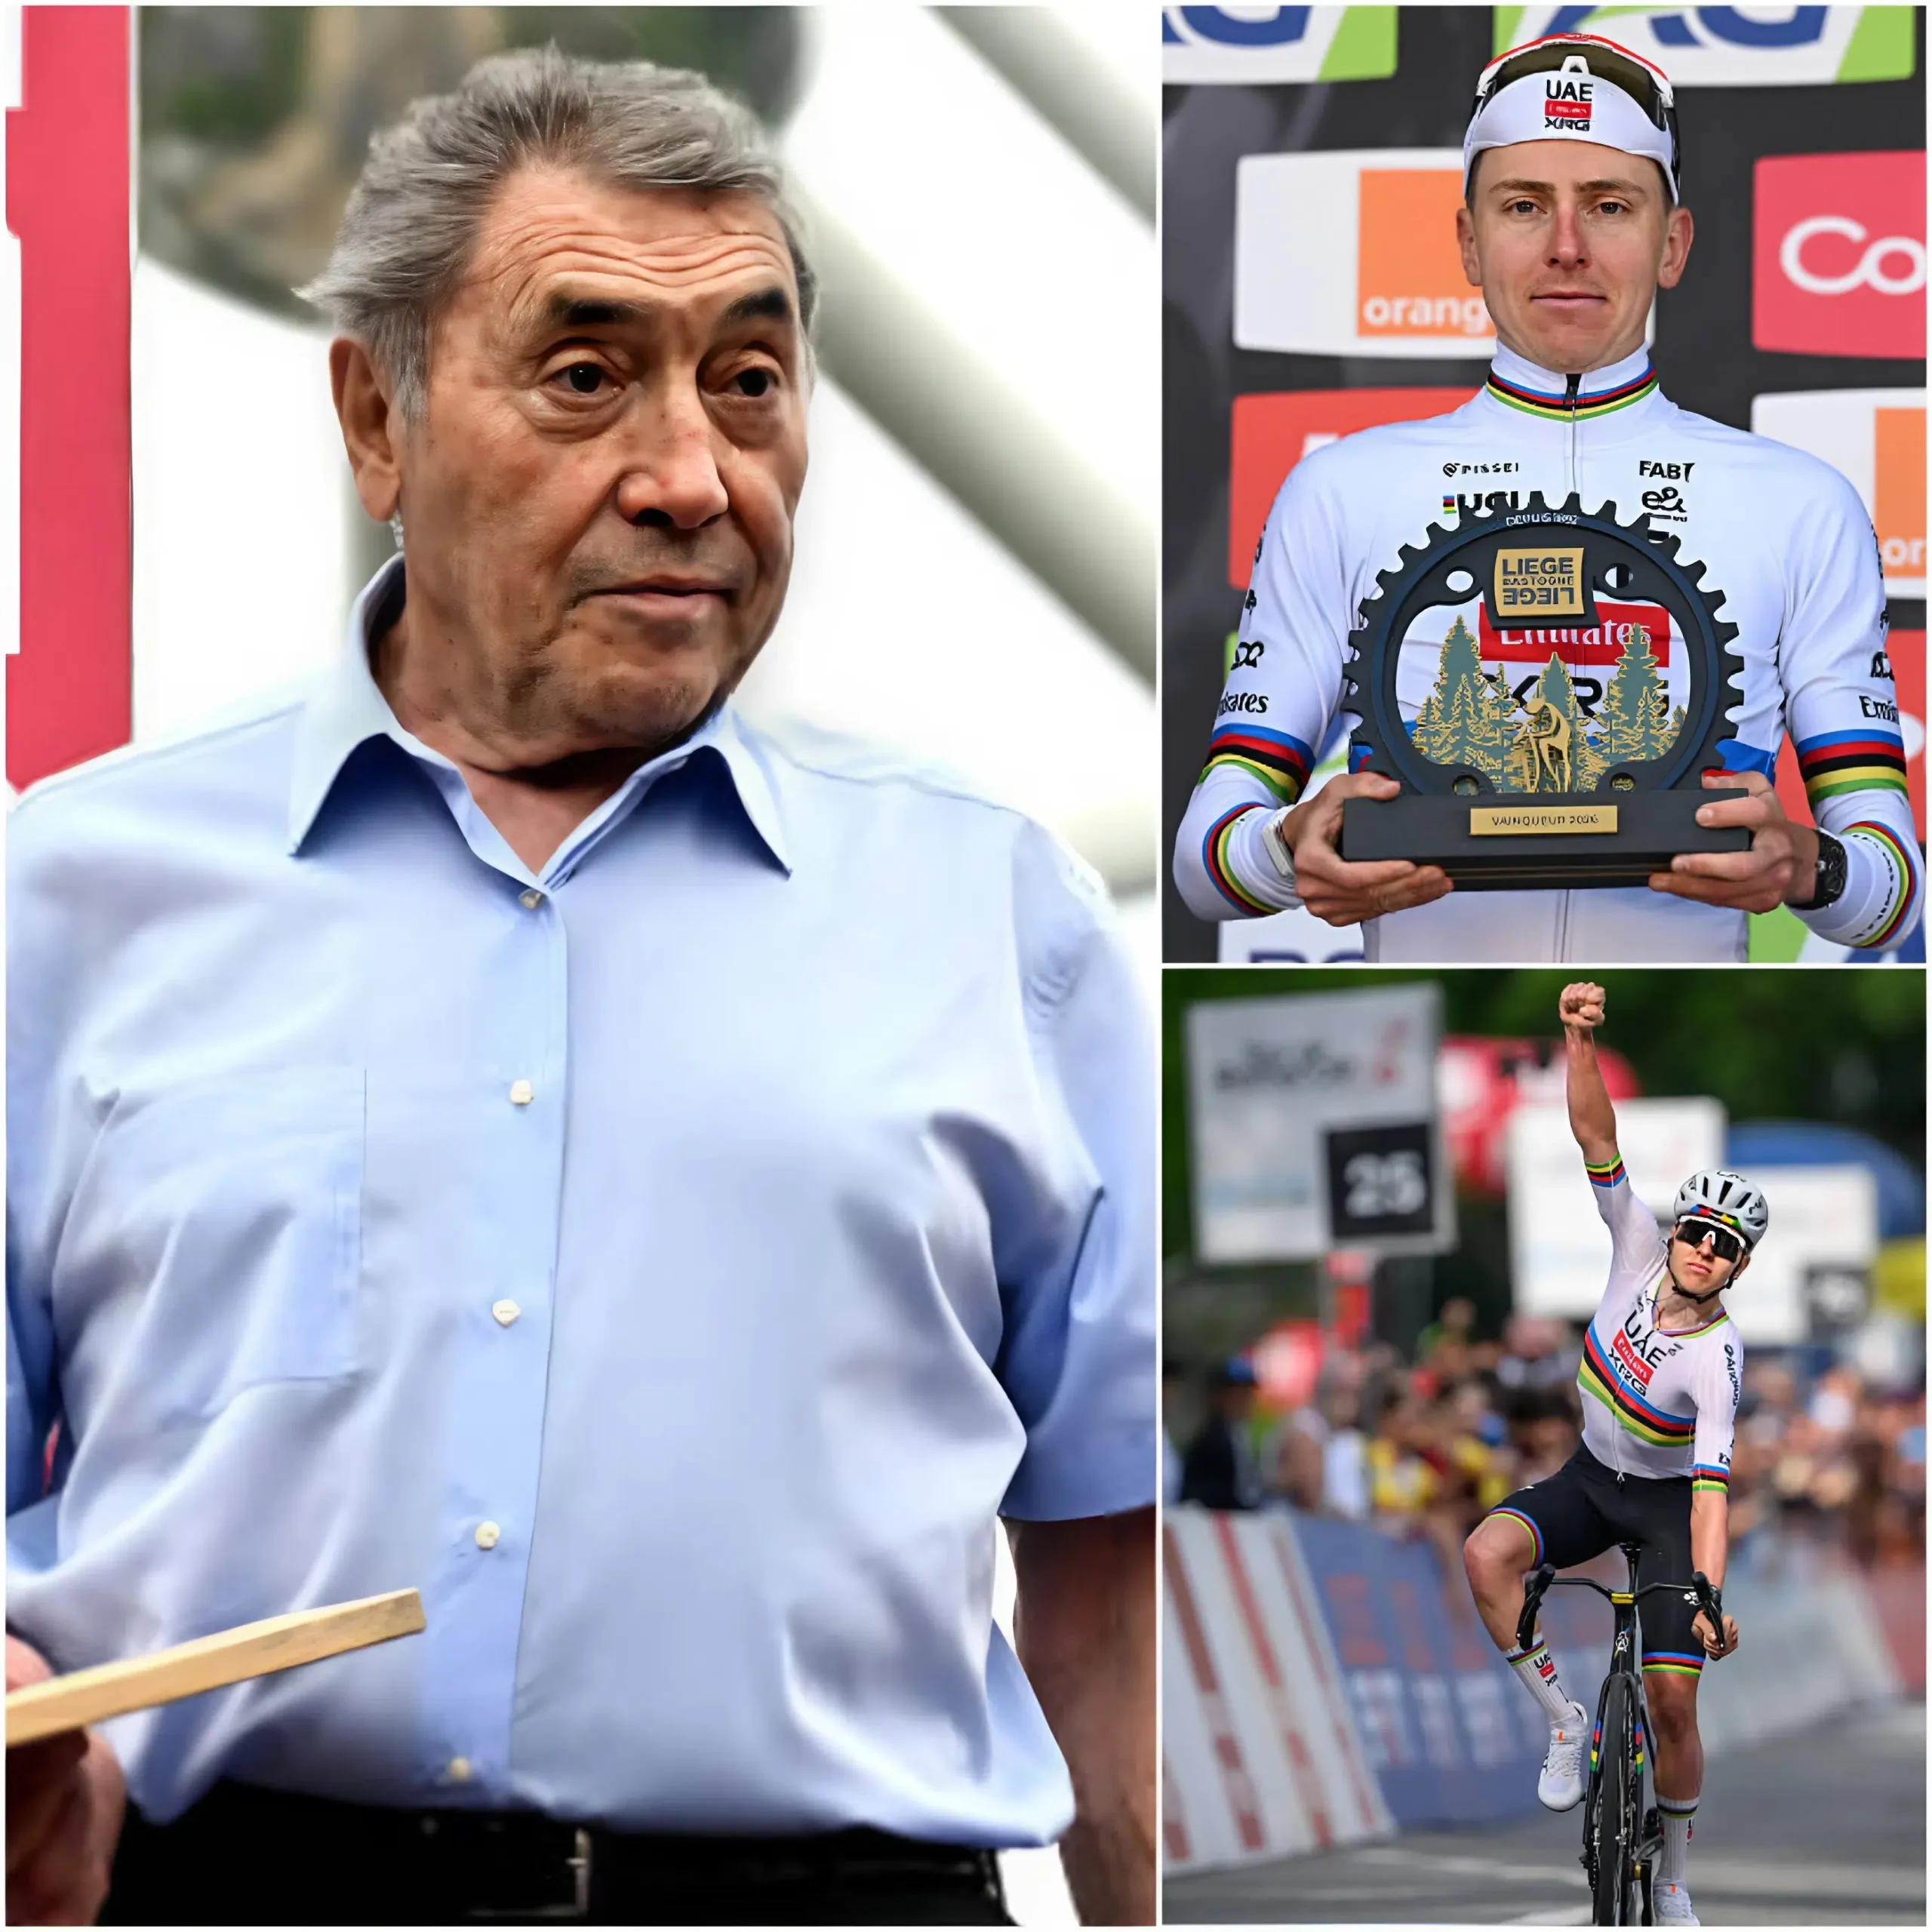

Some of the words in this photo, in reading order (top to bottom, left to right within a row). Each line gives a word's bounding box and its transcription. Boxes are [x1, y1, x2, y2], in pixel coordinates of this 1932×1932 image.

[1546, 79, 1593, 102] UAE
[1780, 215, 1927, 295] Co
[1503, 557, 1574, 576] LIEGE
[1503, 587, 1574, 605] LIEGE
[1344, 1151, 1426, 1218] 25
[1625, 1309, 1667, 1369] UAE
